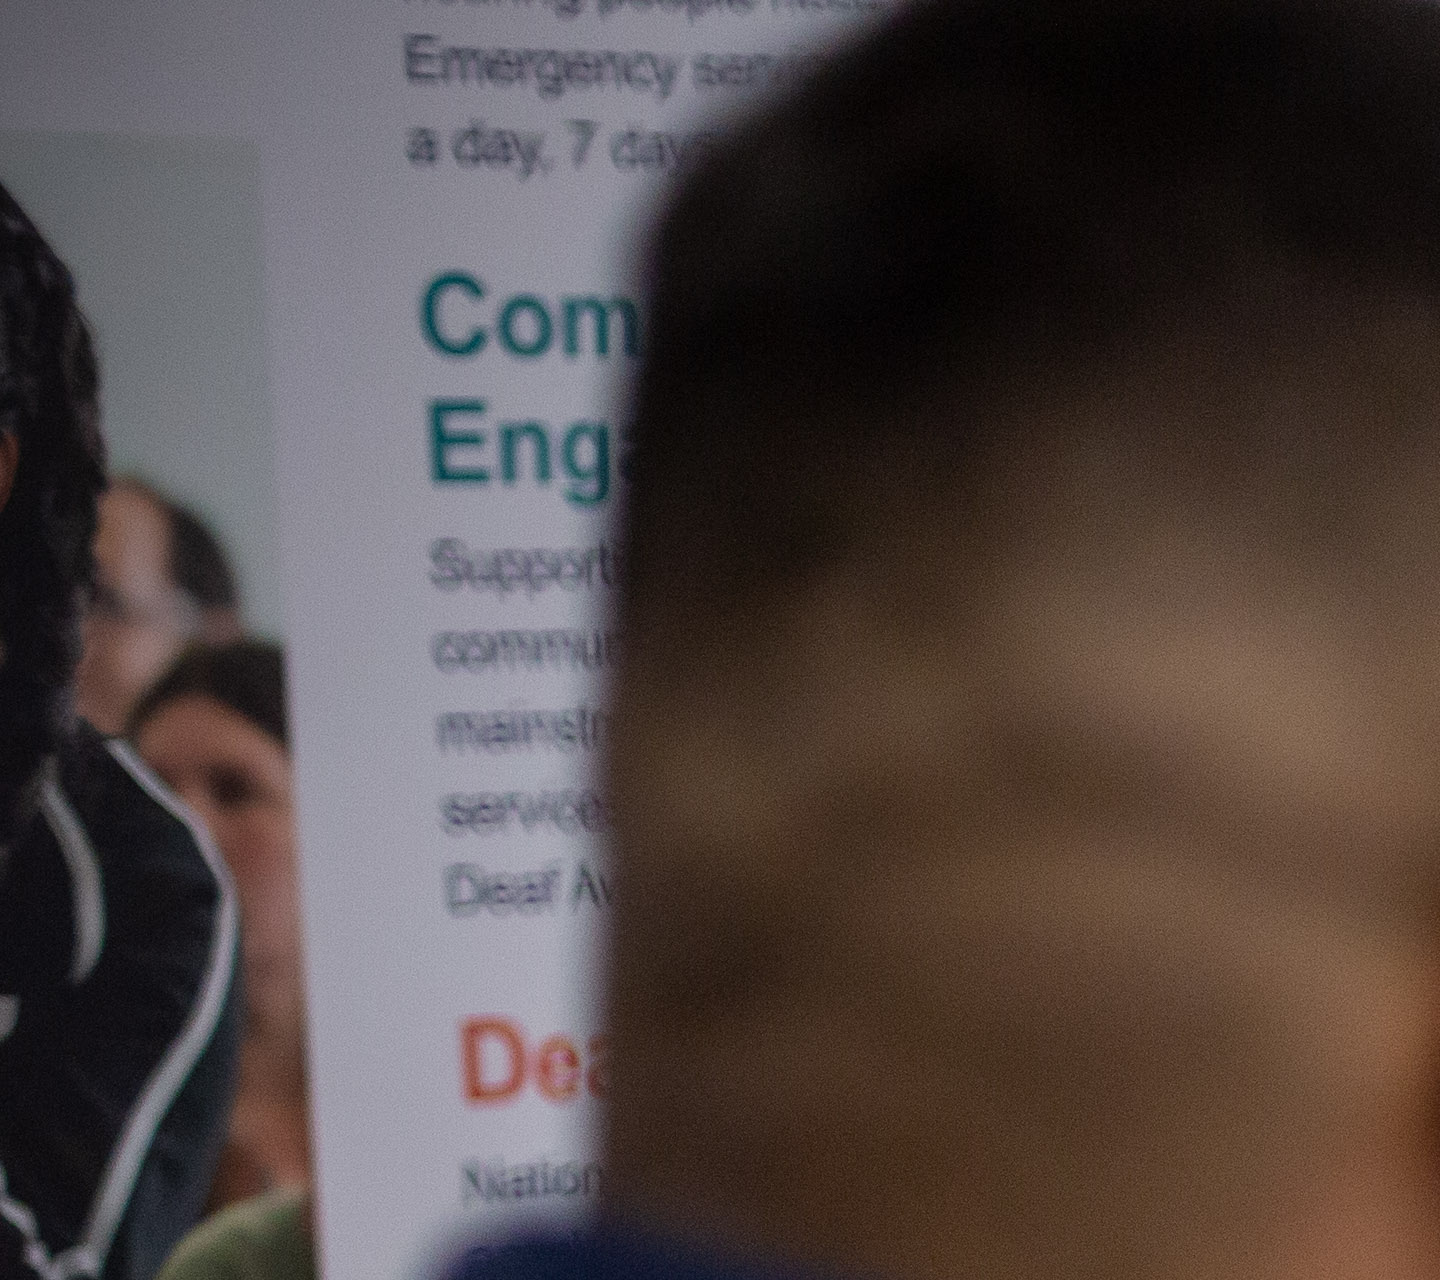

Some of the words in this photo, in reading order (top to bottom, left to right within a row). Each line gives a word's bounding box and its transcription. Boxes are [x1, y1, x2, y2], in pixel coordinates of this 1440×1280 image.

[404, 35, 678, 98] Emergency
[406, 128, 438, 166] a
[568, 120, 598, 164] 7
[421, 270, 641, 358] Com
